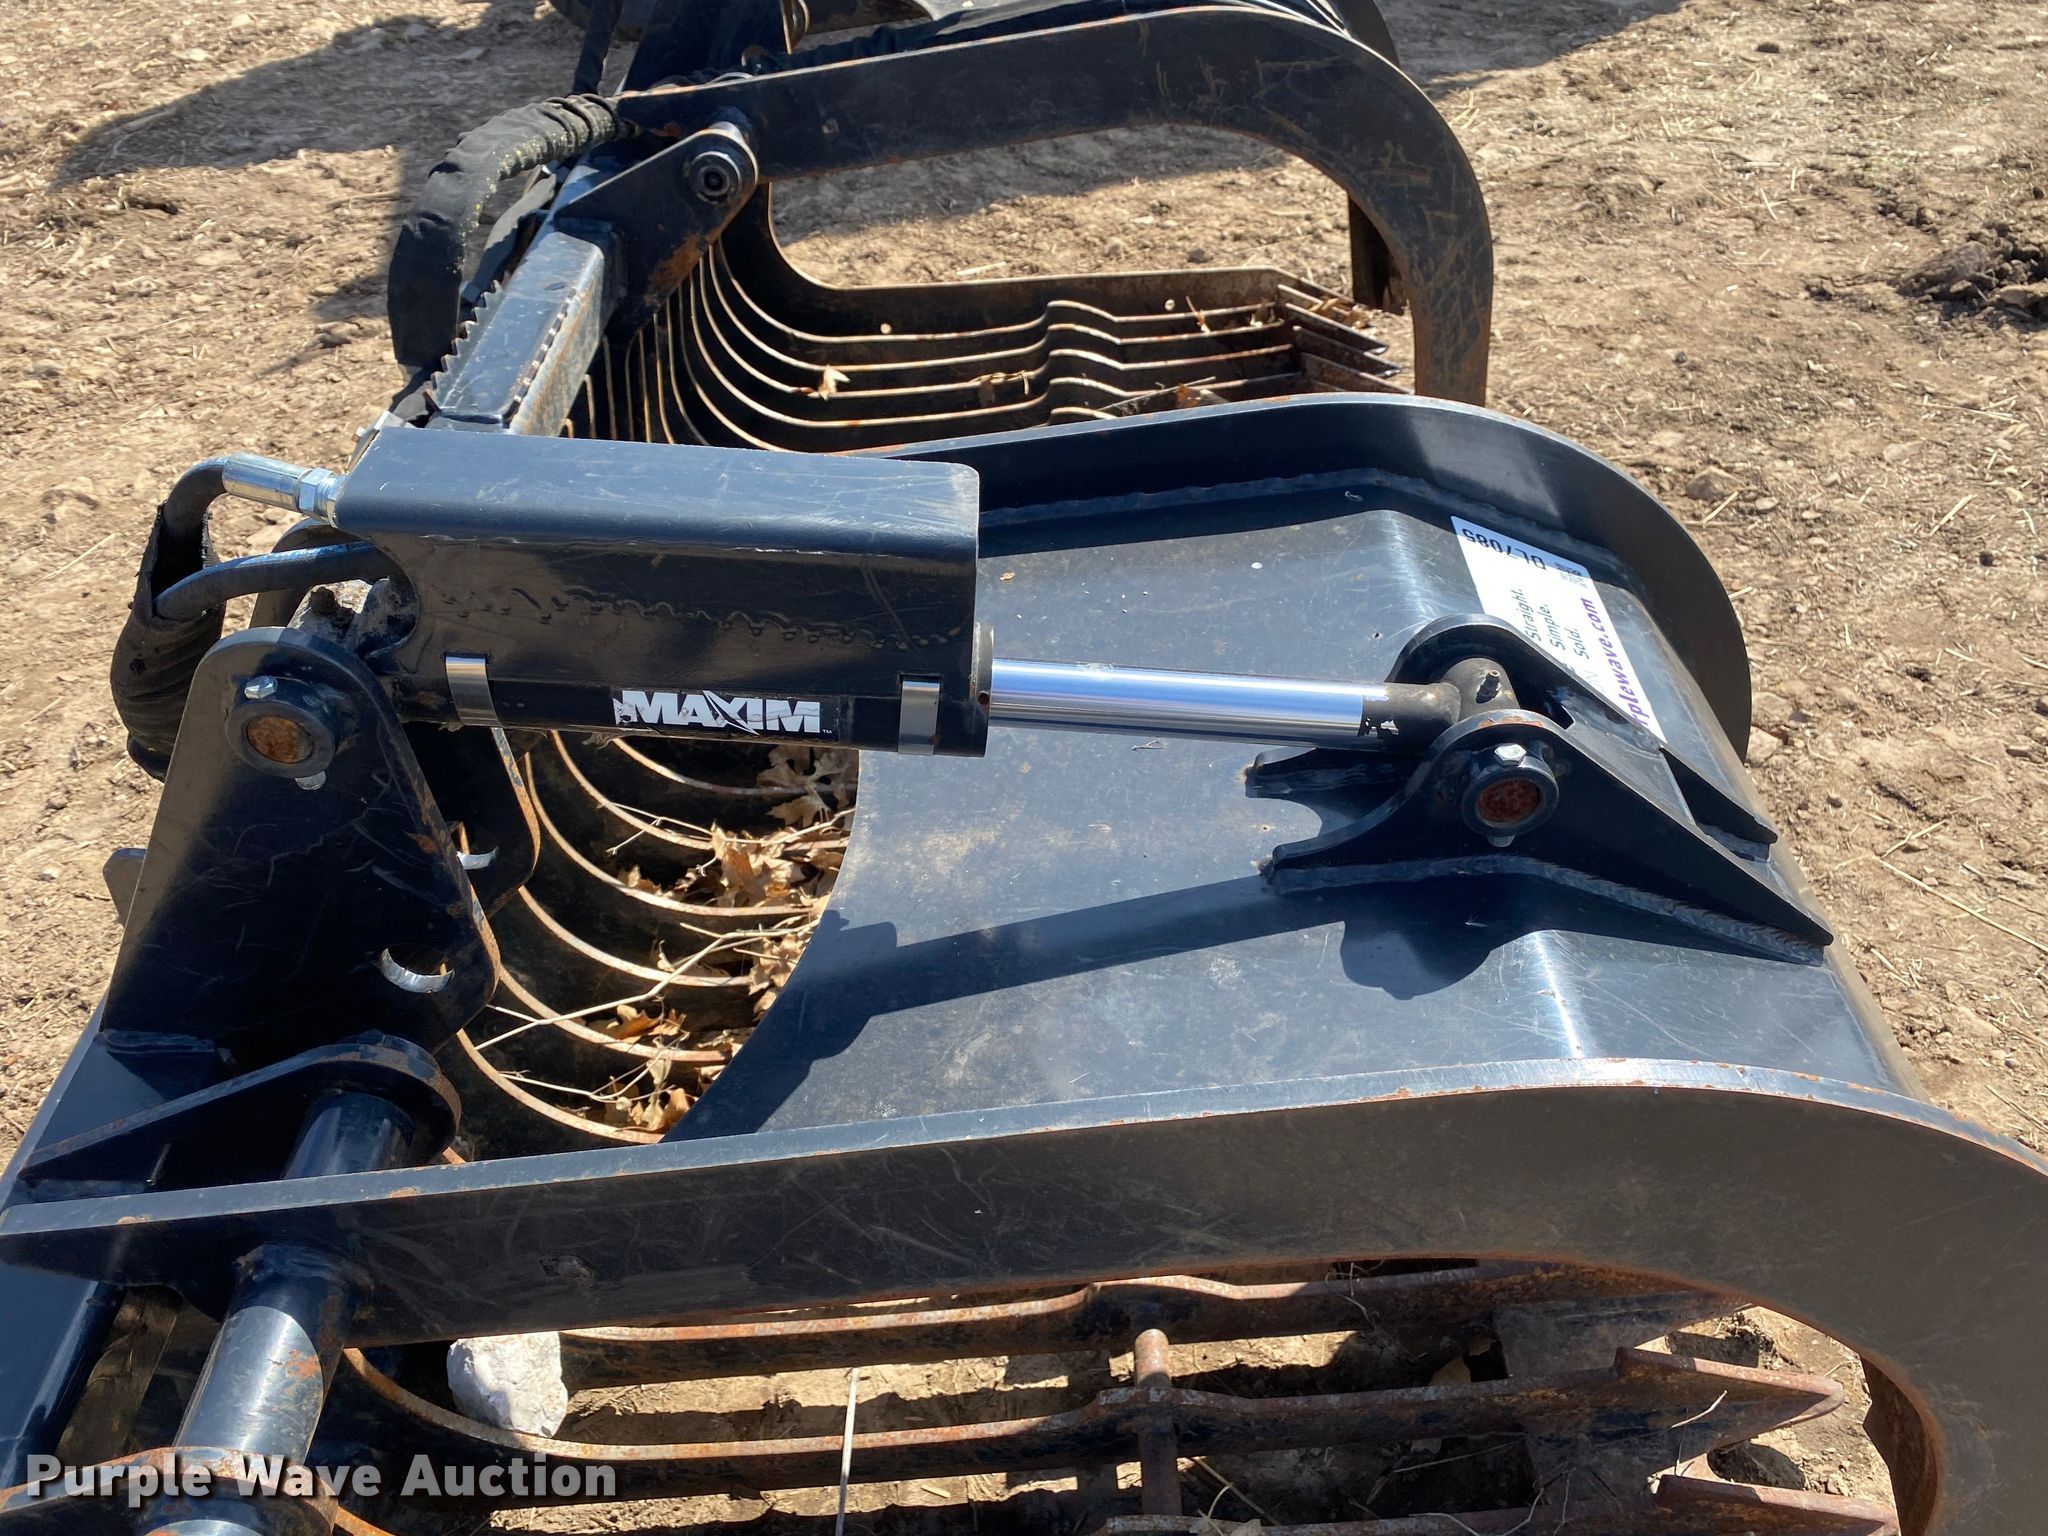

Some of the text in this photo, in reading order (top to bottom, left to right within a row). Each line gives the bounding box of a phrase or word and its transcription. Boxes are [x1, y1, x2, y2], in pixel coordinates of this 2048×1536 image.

[1510, 588, 1542, 642] Straight.
[1537, 604, 1566, 651] Simple.
[1564, 628, 1590, 660] Sold.
[1581, 597, 1650, 726] rplewave.com
[612, 689, 820, 735] MAXIM
